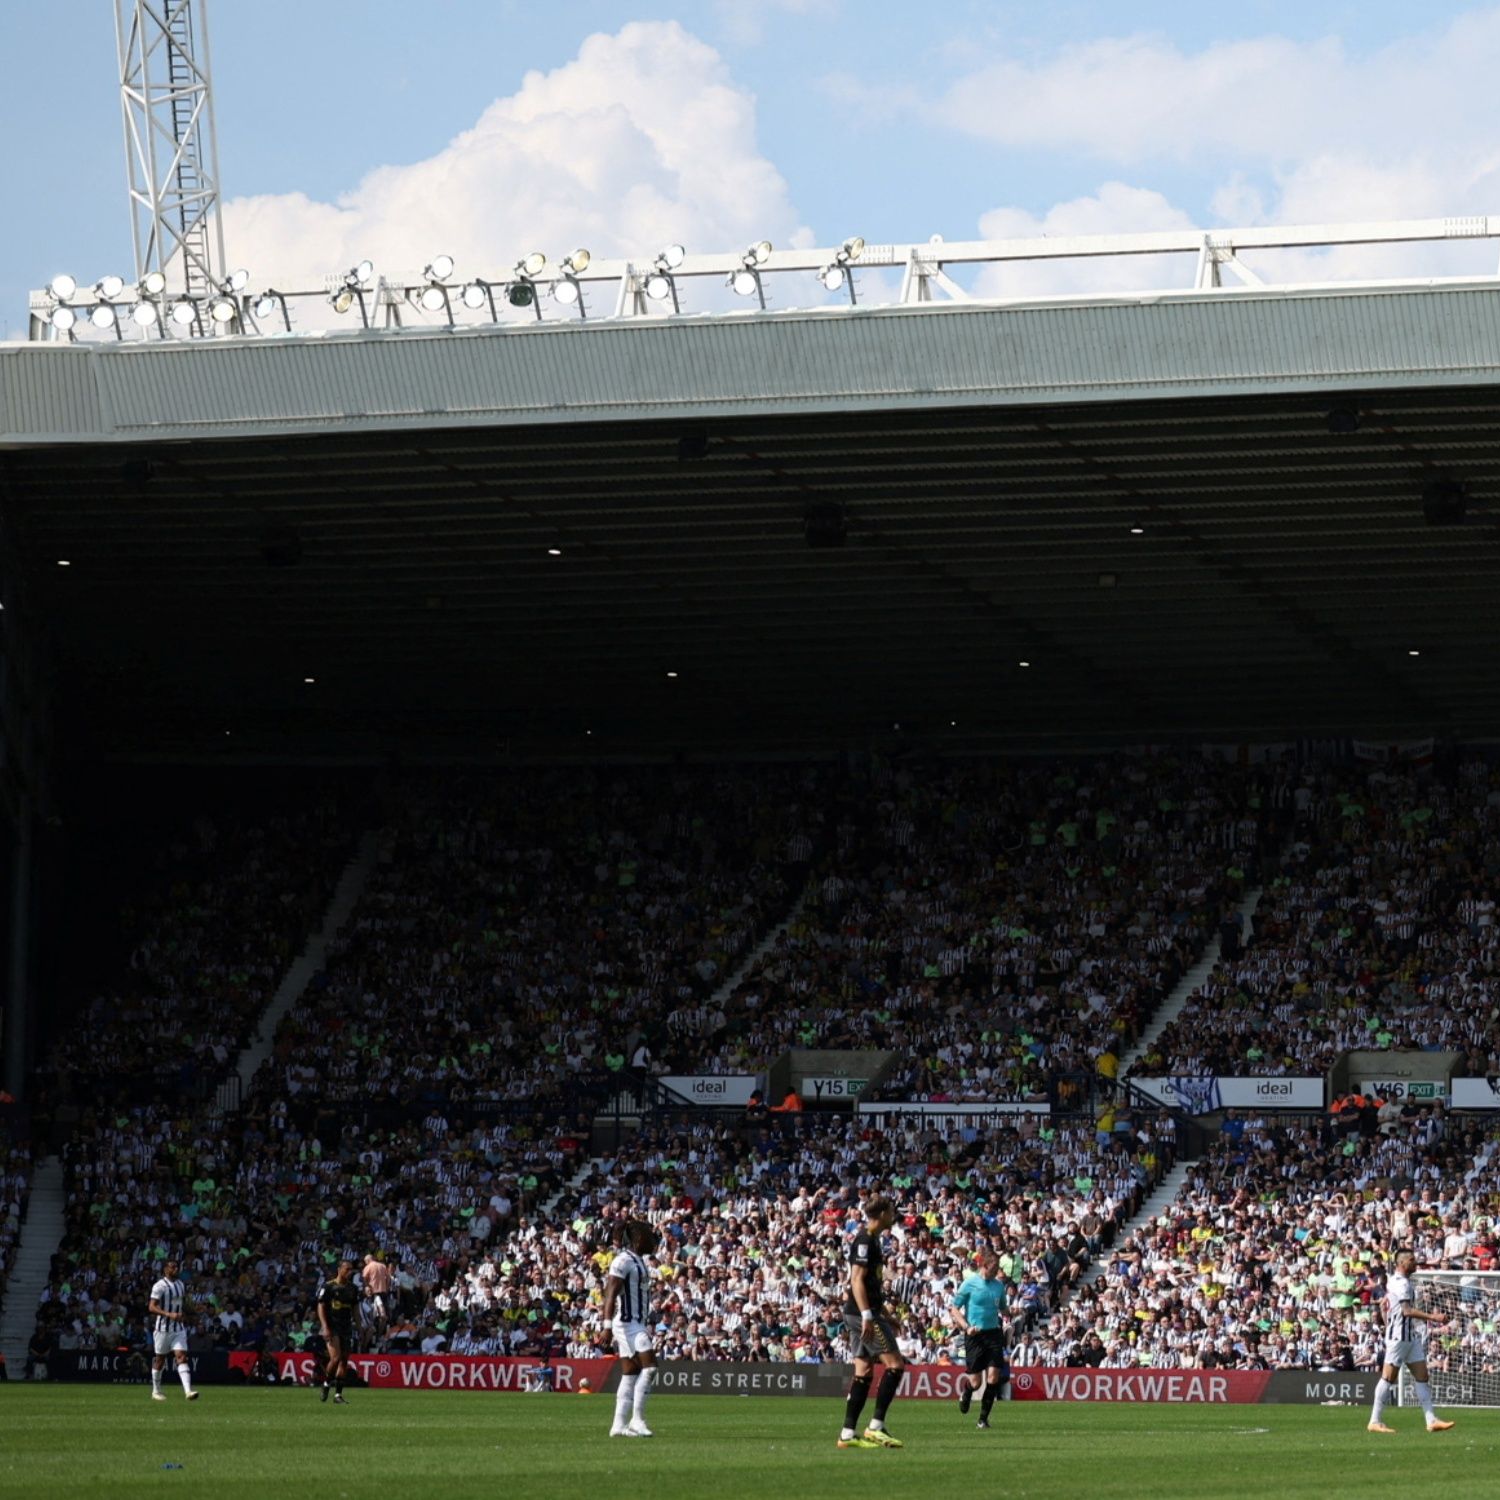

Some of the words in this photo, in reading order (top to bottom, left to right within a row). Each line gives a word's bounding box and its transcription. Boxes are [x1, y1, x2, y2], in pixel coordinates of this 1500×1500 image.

[692, 1079, 726, 1093] ideal
[1257, 1081, 1293, 1095] ideal
[1409, 1085, 1432, 1094] EXIT
[78, 1355, 121, 1371] MARC
[400, 1361, 573, 1388] WORKWER
[712, 1373, 804, 1389] STRETCH
[1043, 1374, 1228, 1402] WORKWEAR
[1306, 1383, 1365, 1398] MORE
